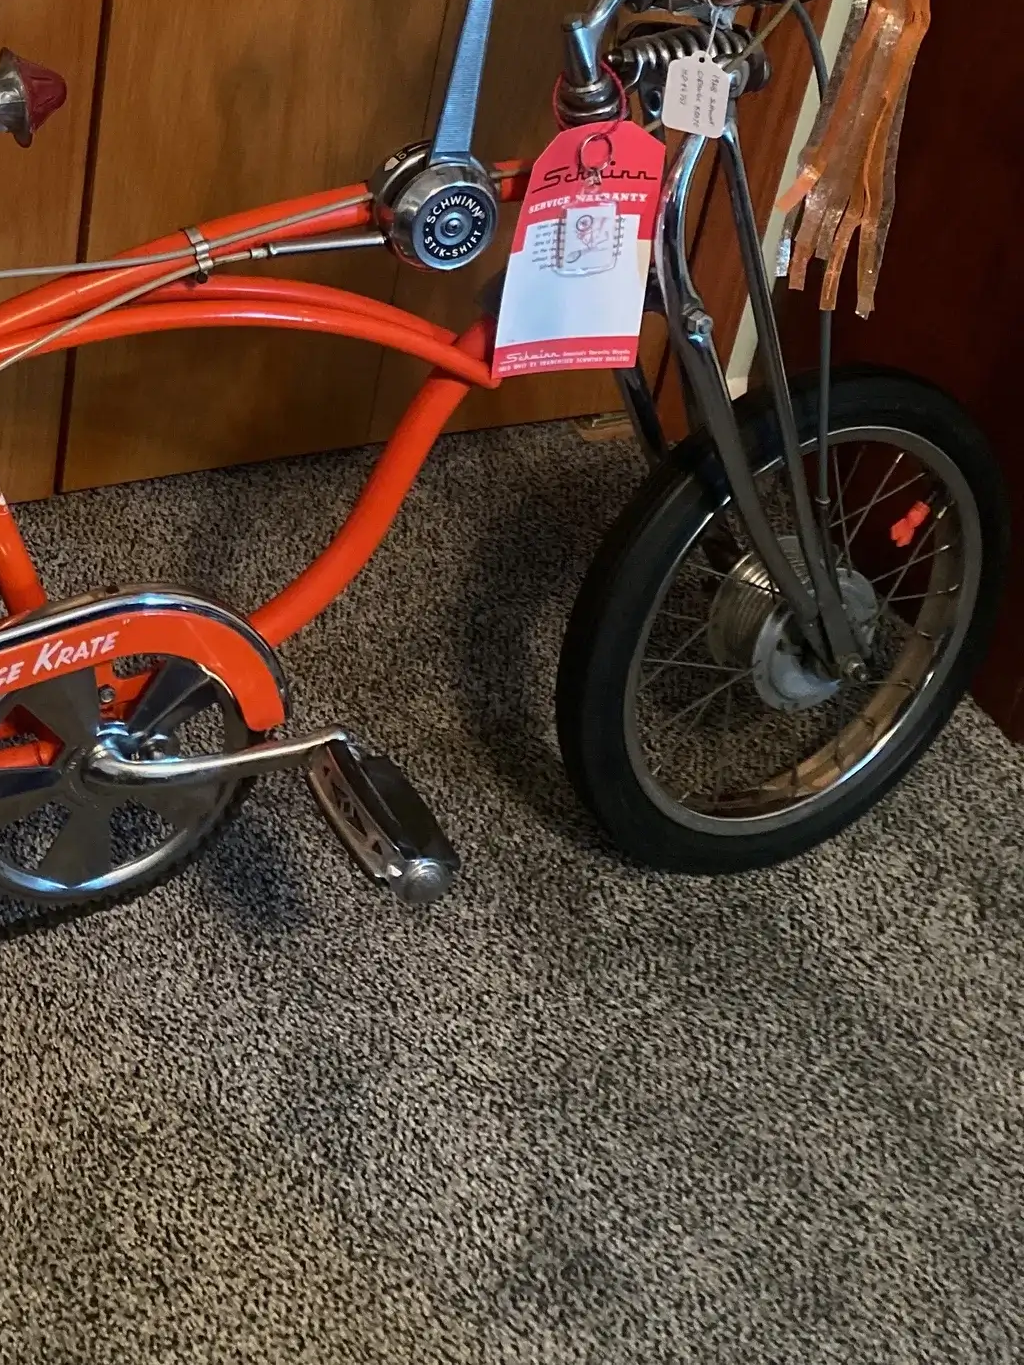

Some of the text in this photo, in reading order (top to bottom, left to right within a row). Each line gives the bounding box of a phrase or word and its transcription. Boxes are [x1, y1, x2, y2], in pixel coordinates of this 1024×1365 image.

[426, 194, 483, 225] SCHWINN
[528, 196, 571, 214] SERVICE
[424, 229, 483, 257] STIK-SHIFT
